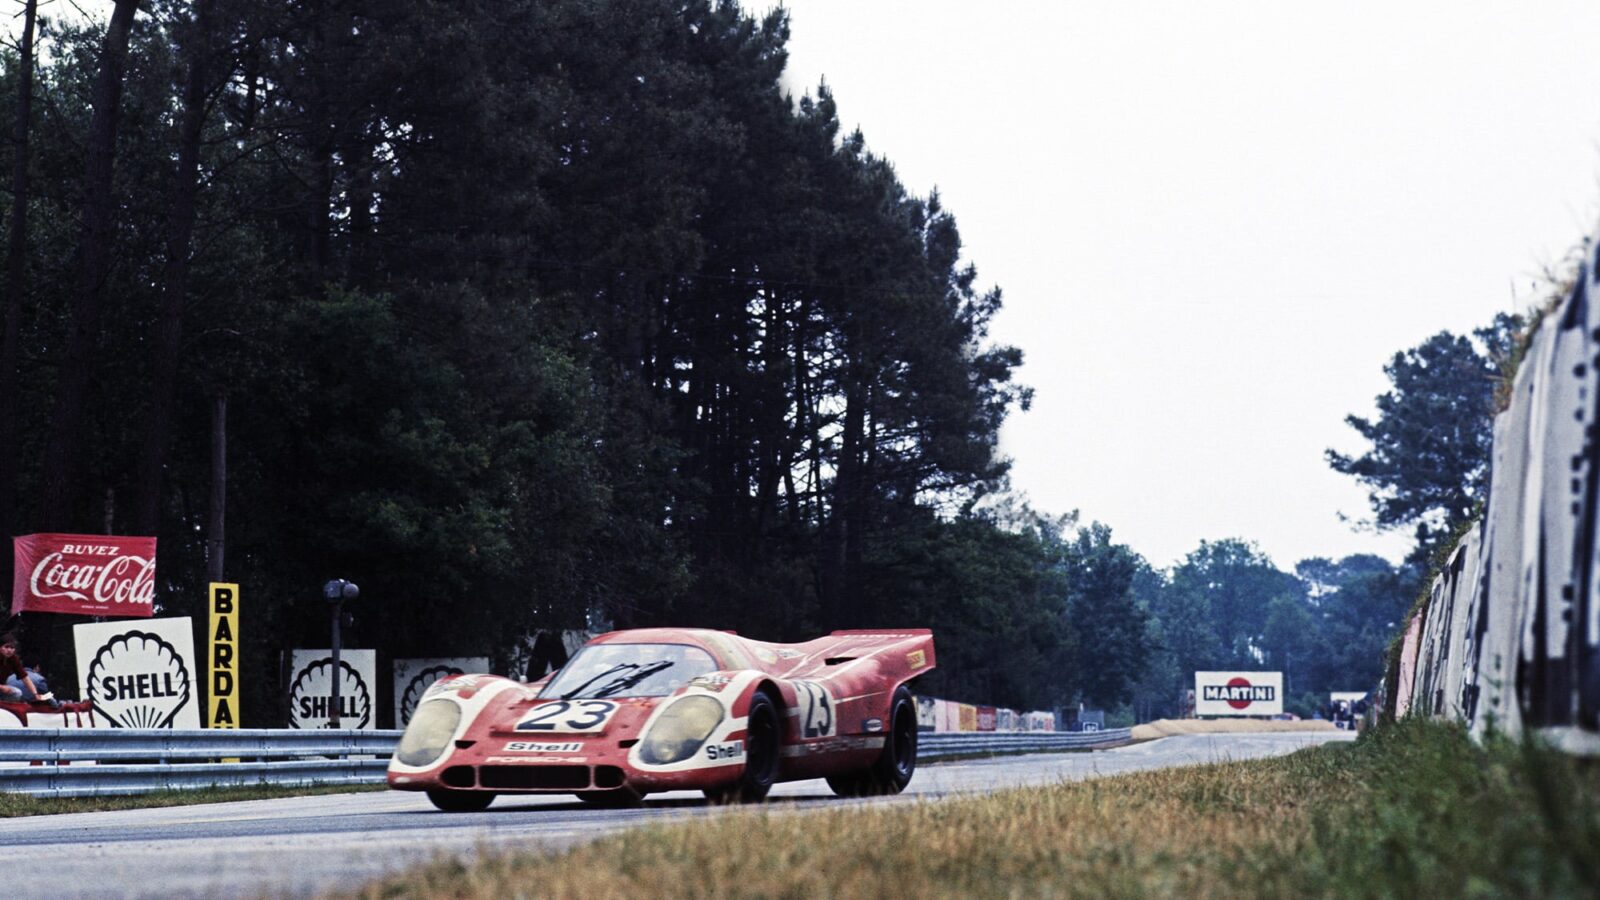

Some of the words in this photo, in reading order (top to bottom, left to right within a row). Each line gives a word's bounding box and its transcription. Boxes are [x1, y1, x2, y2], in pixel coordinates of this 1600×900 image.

[61, 544, 120, 556] BUVEZ
[30, 552, 156, 604] Coca-Cola
[214, 588, 233, 729] BARDA
[102, 672, 178, 701] SHELL
[1205, 687, 1273, 700] MARTINI
[516, 701, 615, 730] 23
[508, 742, 580, 752] Shell
[706, 742, 742, 760] Shell
